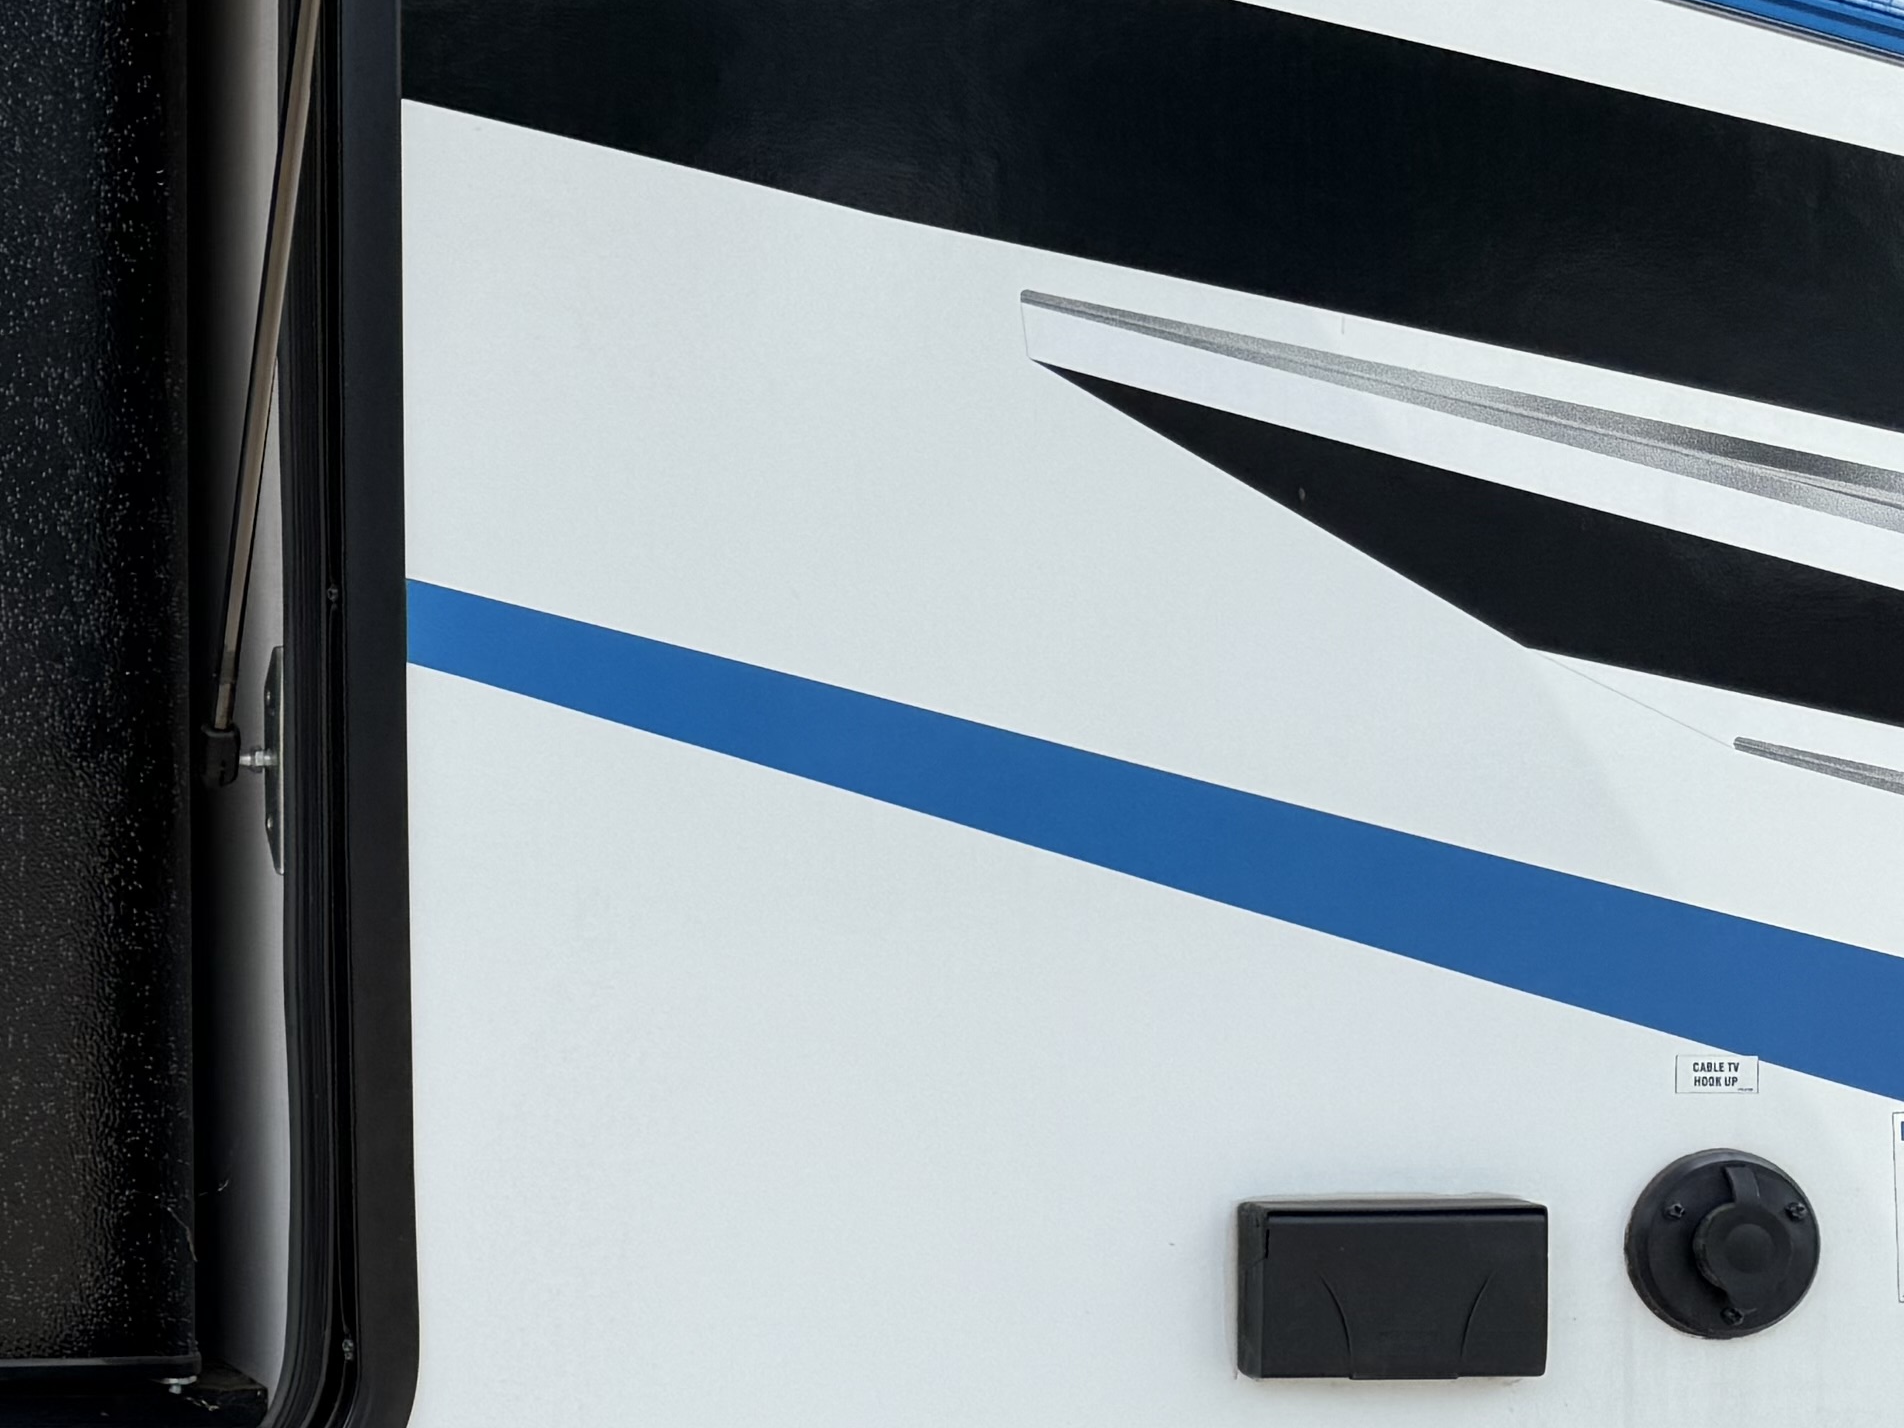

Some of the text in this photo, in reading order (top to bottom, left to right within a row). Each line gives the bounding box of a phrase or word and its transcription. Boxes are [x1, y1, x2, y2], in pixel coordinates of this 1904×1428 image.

[1693, 1062, 1740, 1072] CABLE TV
[1694, 1076, 1738, 1087] HOOK UP
